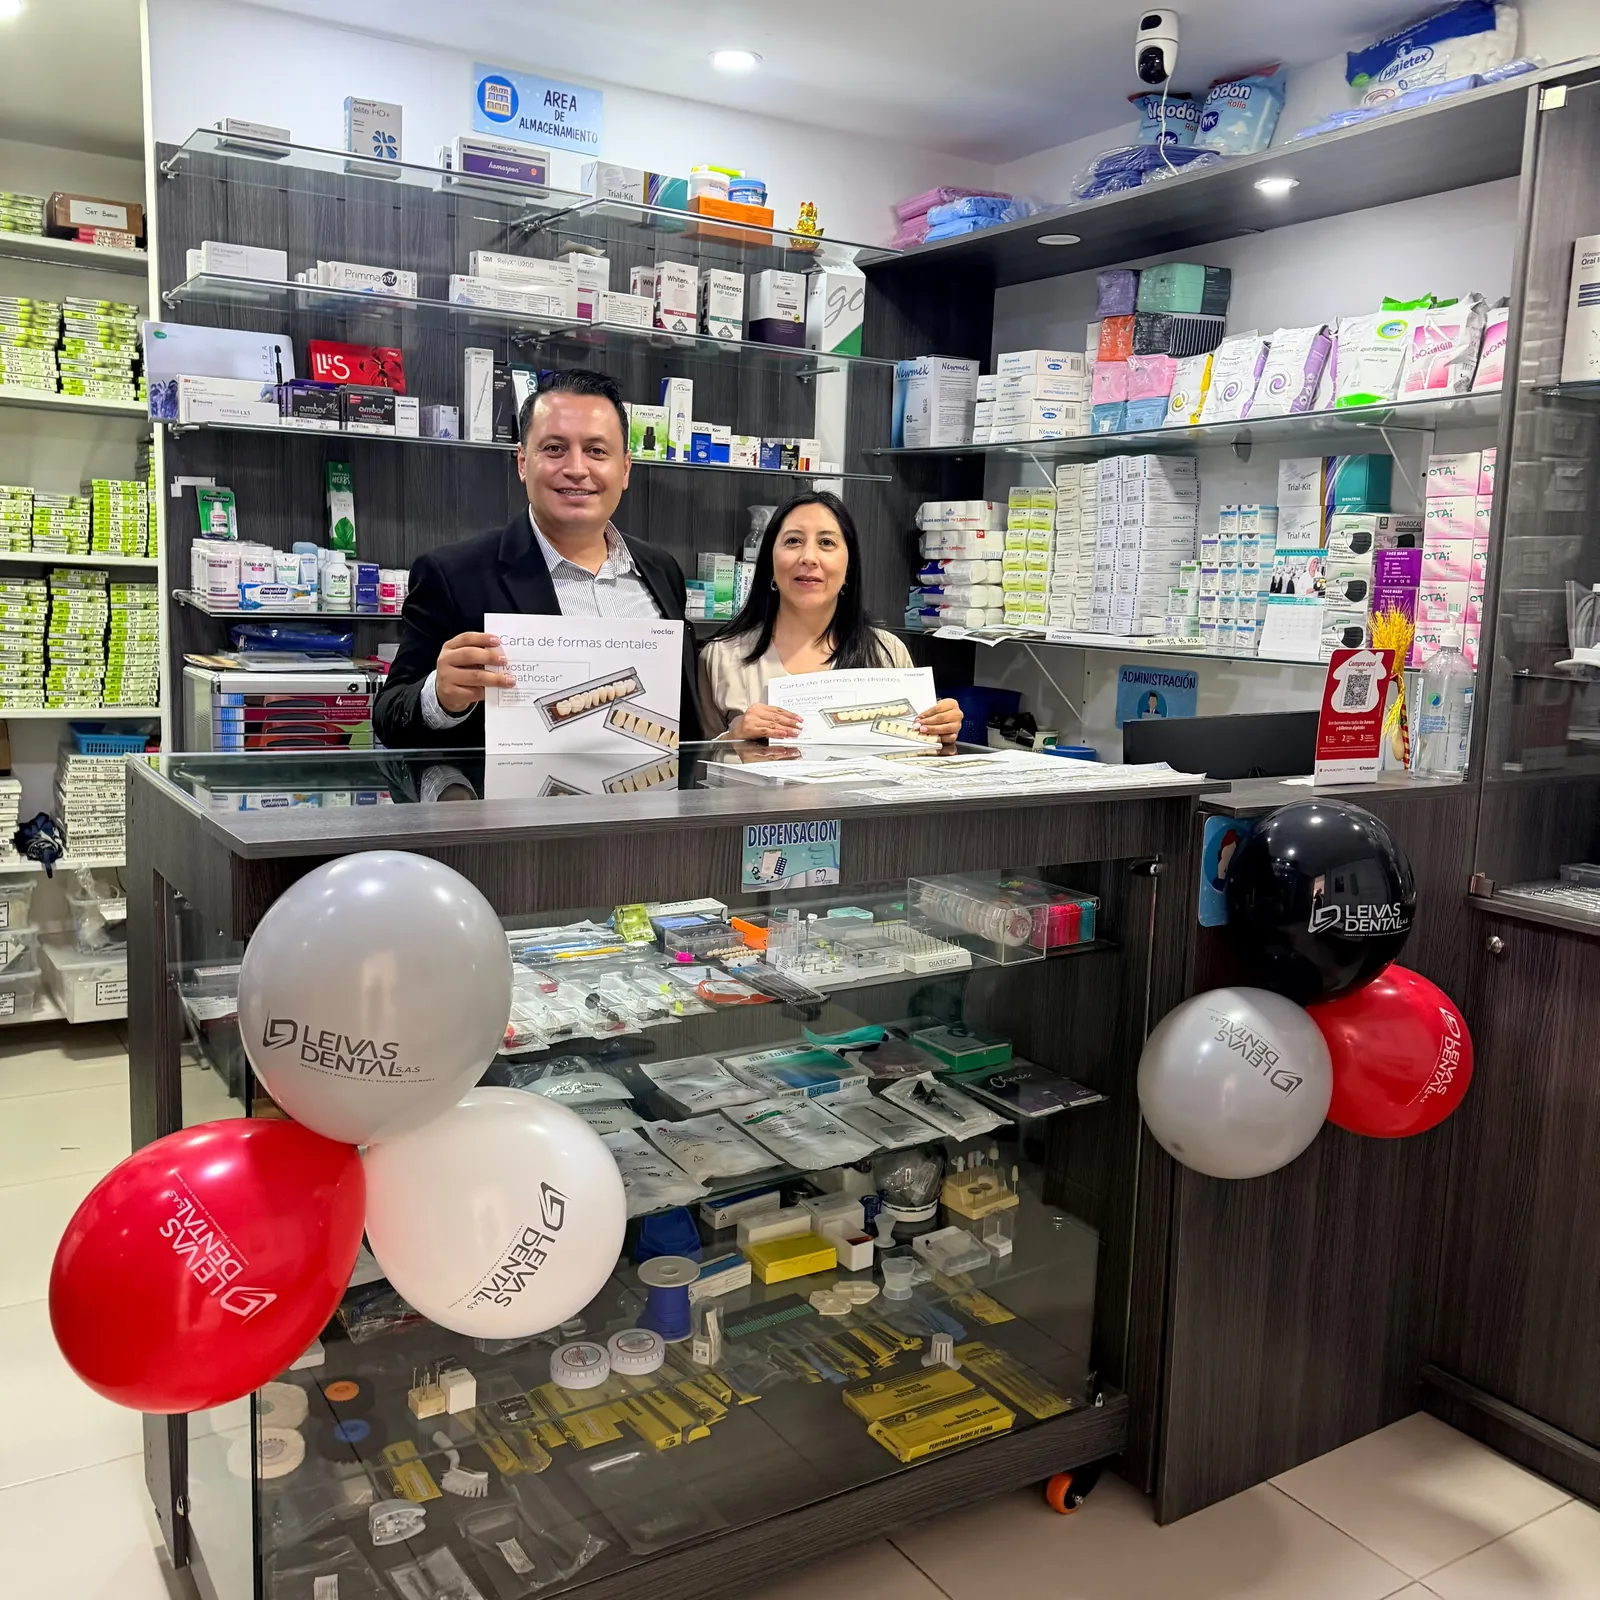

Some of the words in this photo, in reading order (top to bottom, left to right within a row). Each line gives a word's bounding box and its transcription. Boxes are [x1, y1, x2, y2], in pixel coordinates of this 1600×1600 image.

[1383, 52, 1428, 79] Higietex
[543, 89, 577, 112] AREA
[1226, 99, 1246, 110] Rollo
[554, 109, 565, 122] DE
[1202, 116, 1218, 128] MK
[518, 116, 598, 144] ALMACENAMIENTO
[606, 188, 634, 201] Trial-Kit
[482, 255, 493, 263] 3M
[712, 281, 742, 293] Whiteness
[1287, 482, 1312, 492] Trial-Kit
[1286, 530, 1311, 540] Trial-Kit
[650, 627, 675, 636] ivoclar
[499, 635, 535, 647] Carta
[537, 636, 555, 647] de
[557, 637, 602, 649] formas
[604, 638, 658, 650] dentales
[779, 682, 805, 690] Carta
[819, 675, 852, 685] formas
[867, 675, 901, 683] dientes
[1121, 671, 1196, 689] ADMINISTRACIÓN
[747, 820, 838, 847] DISPENSACION
[1345, 903, 1401, 919] LEIVAS
[1344, 917, 1402, 932] DENTAL
[928, 957, 957, 969] DIATECH
[303, 1024, 400, 1060] LEIVAS
[1219, 1016, 1281, 1065] DENTAL
[300, 1044, 402, 1078] DENTAL
[1213, 1028, 1274, 1077] LEIVAS
[1425, 1037, 1454, 1095] DENTAL
[1436, 1041, 1462, 1096] LEIVAS
[175, 1197, 244, 1283] DENTAL
[158, 1217, 228, 1297] LEIVAS
[472, 1226, 541, 1301] DENTAL
[493, 1233, 556, 1308] LEIVAS
